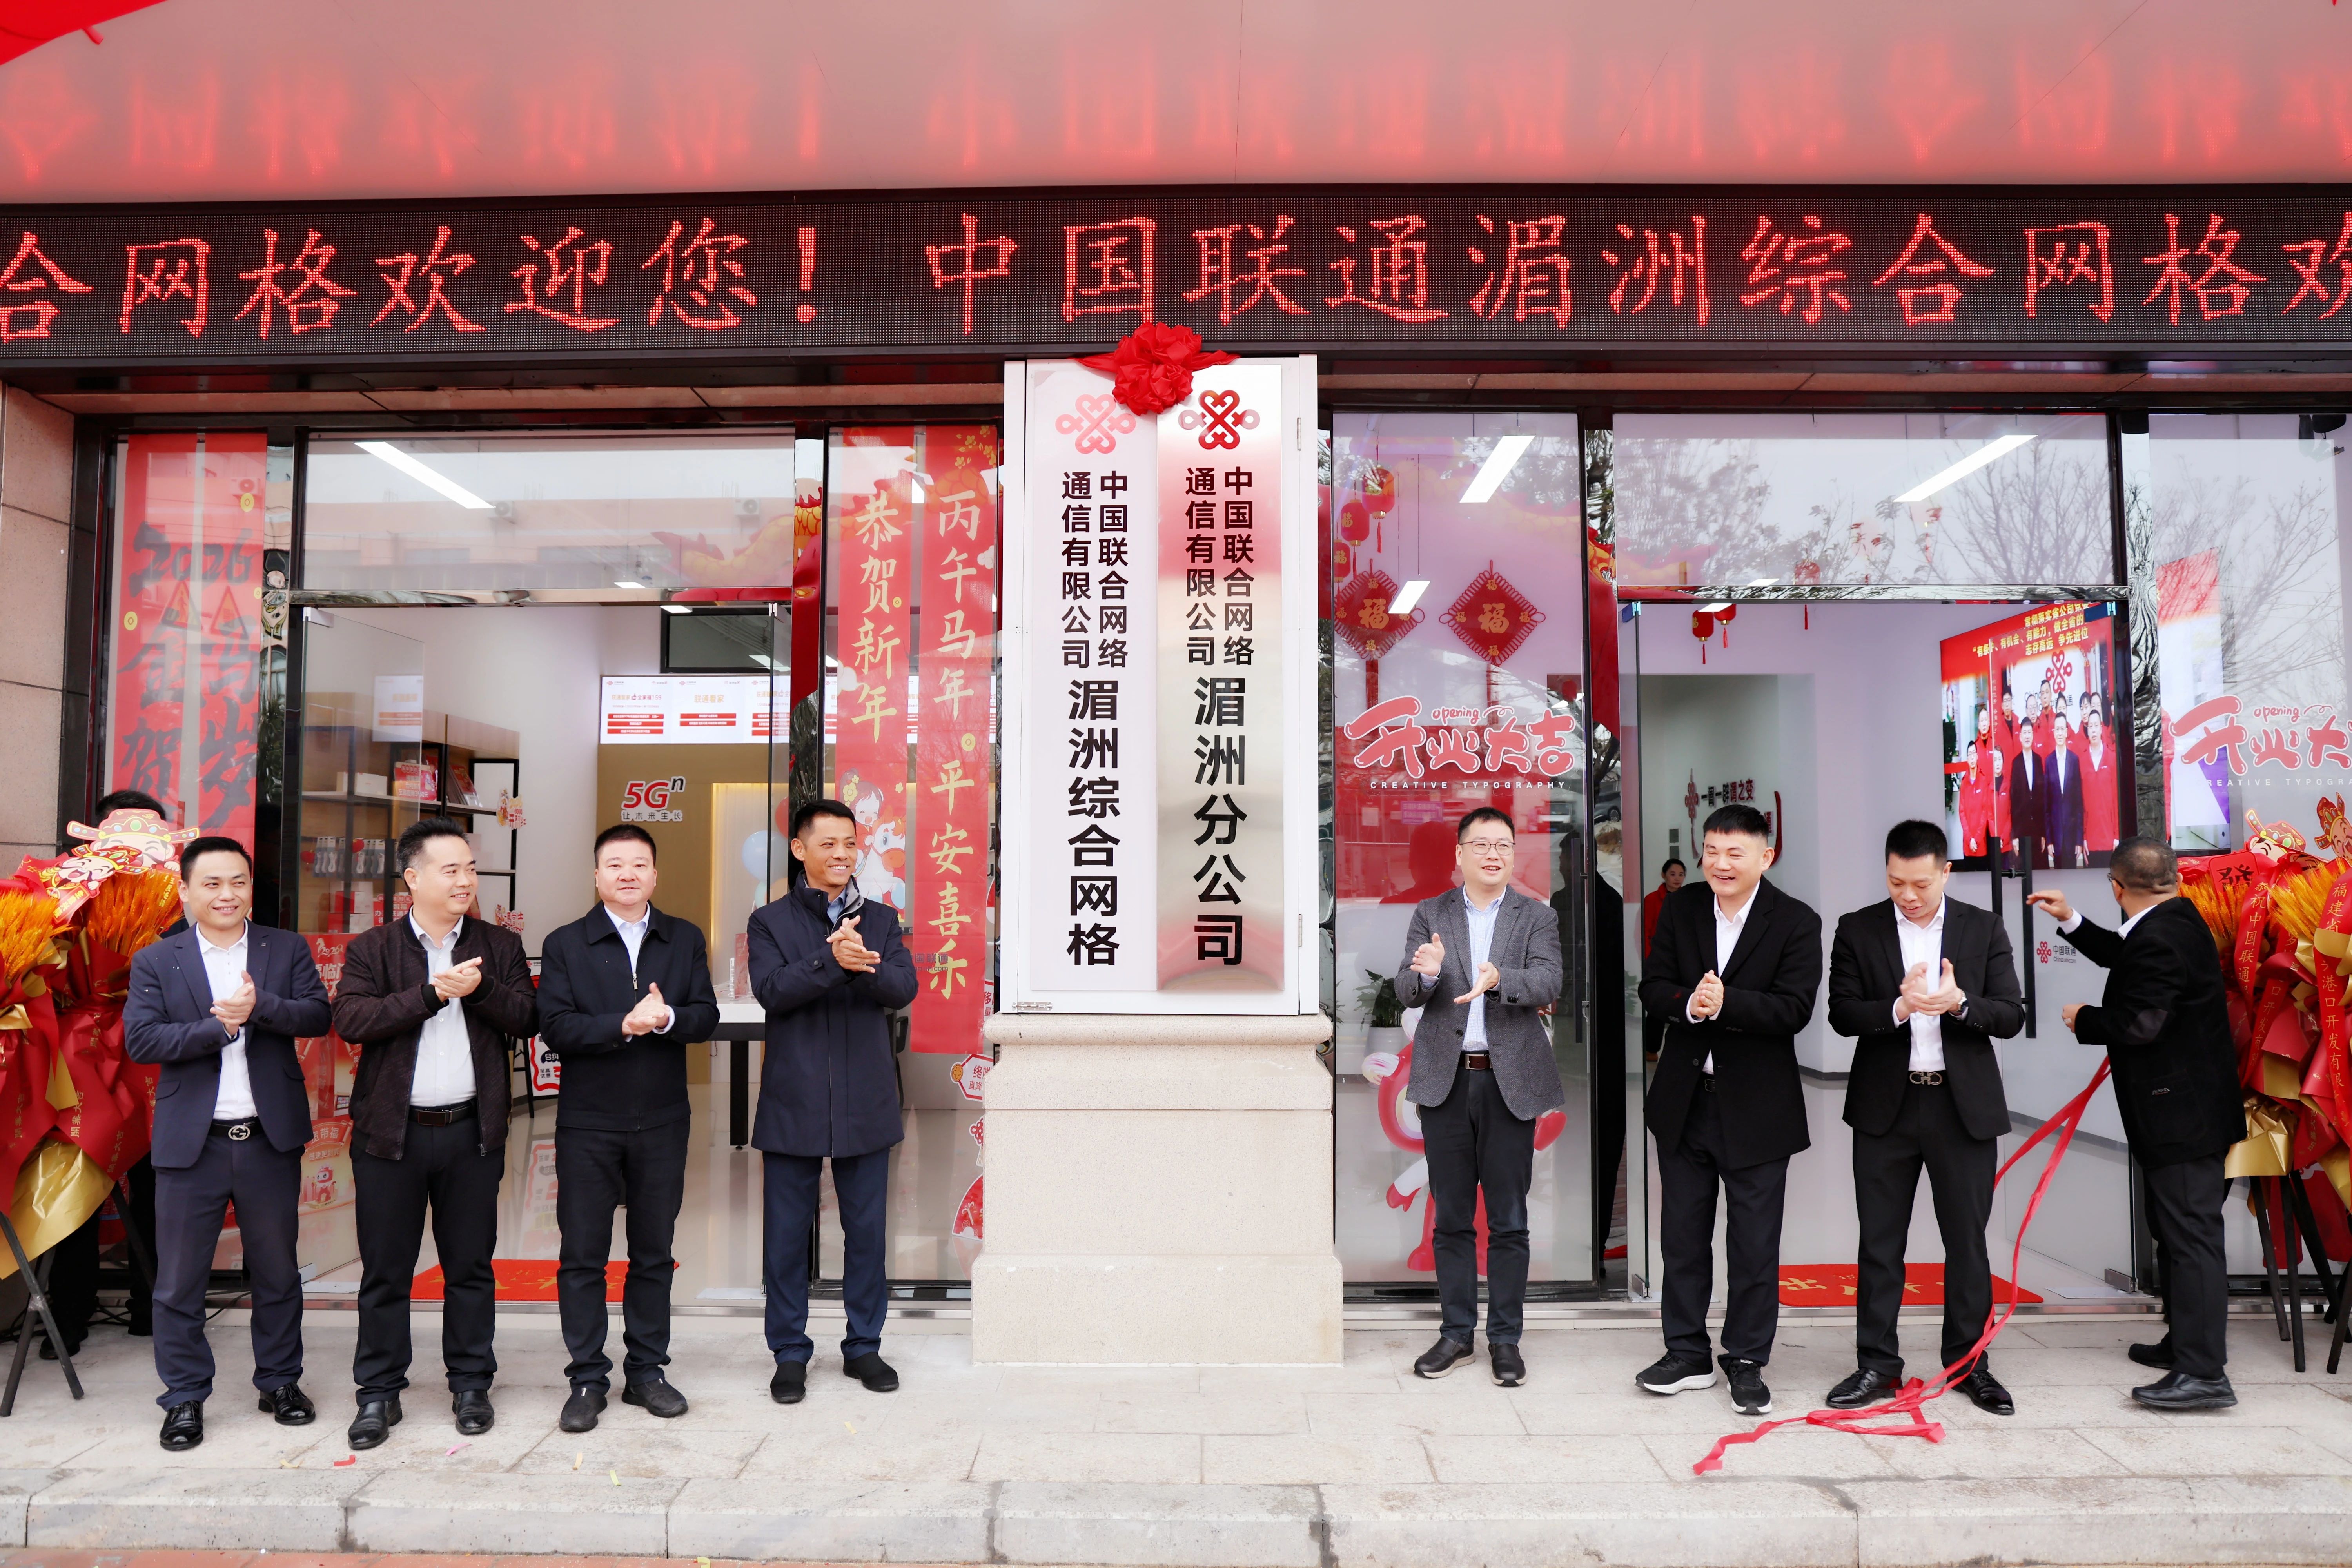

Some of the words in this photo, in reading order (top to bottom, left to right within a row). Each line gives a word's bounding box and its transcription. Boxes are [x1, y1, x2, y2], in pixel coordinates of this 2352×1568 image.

[128, 521, 257, 598] 2026
[1061, 471, 1092, 668] 通信有限公司
[1098, 471, 1129, 668] 中国联合网络
[1185, 468, 1216, 666] 通信有限公司
[1223, 466, 1254, 666] 中国联合网络
[851, 489, 903, 743] 恭贺新年
[933, 490, 980, 720] 丙午马年
[1358, 598, 1389, 629] 福
[1478, 603, 1509, 633] 福
[2025, 637, 2054, 656] 志存高远
[2058, 627, 2089, 647] 争先进位
[1344, 695, 1575, 778] 开业大吉
[1432, 707, 1480, 722] opening
[2169, 695, 2352, 775] 开业大
[2254, 705, 2301, 722] opening
[621, 811, 682, 820] 让未来生长
[1066, 679, 1120, 965] 湄洲综合网格
[1193, 677, 1247, 965] 湄洲分公司
[928, 759, 975, 999] 平安喜乐
[910, 953, 948, 964] 国联通
[2053, 945, 2076, 956] 中国联通
